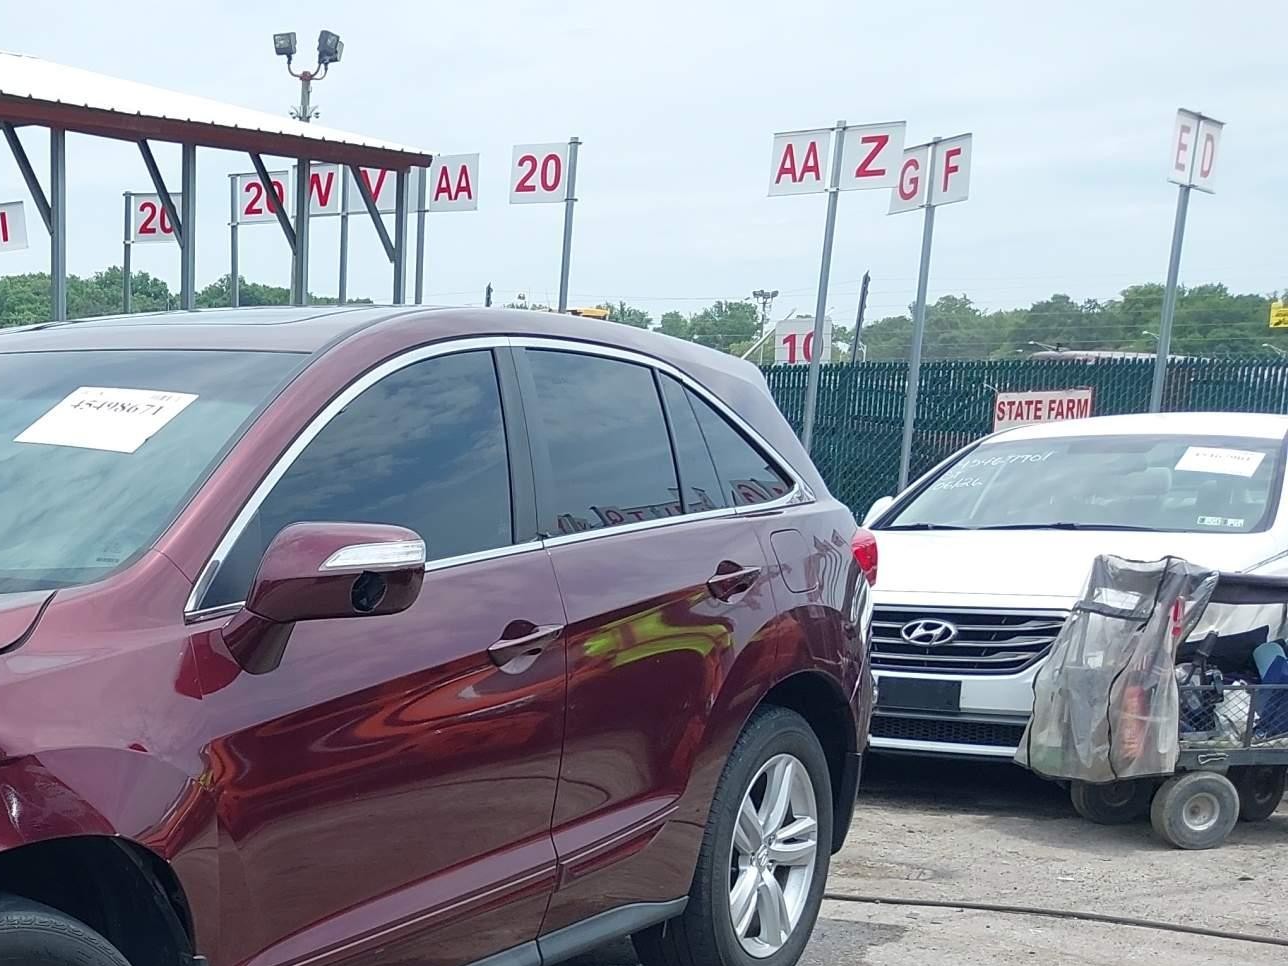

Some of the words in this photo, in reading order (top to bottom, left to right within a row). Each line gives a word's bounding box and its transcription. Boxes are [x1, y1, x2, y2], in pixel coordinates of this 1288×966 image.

[775, 142, 821, 184] AA
[855, 135, 889, 178] Z
[1175, 124, 1191, 172] E
[1200, 132, 1215, 178] D
[434, 164, 472, 201] AA
[515, 153, 562, 193] 20
[898, 158, 920, 201] G
[942, 147, 962, 192] F
[244, 181, 285, 215] 20
[997, 400, 1043, 421] STATE
[1047, 398, 1089, 420] FARM
